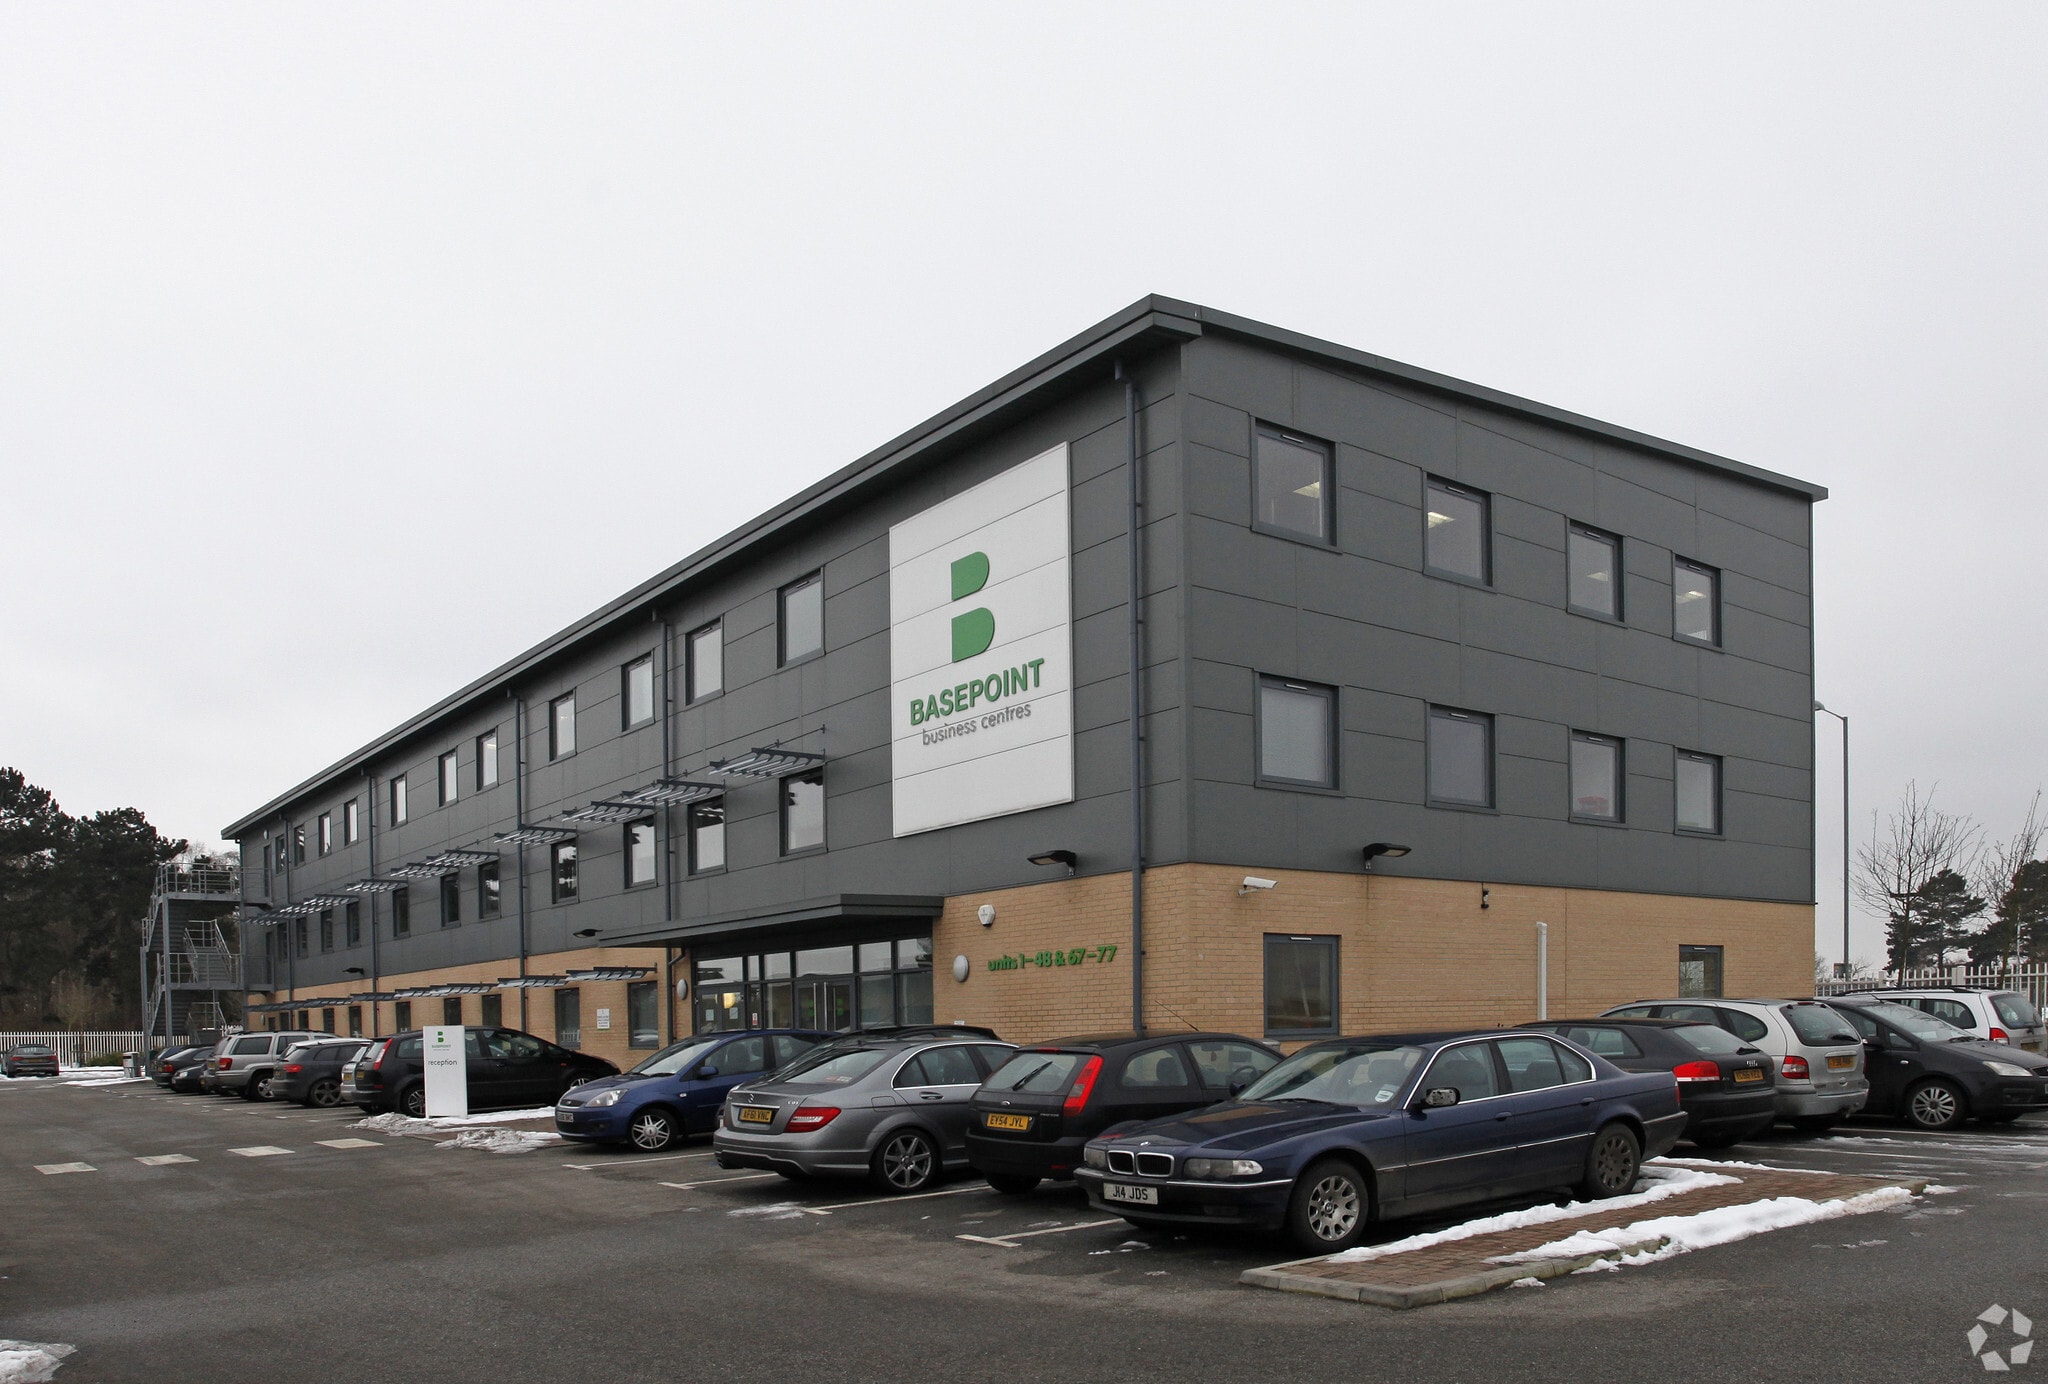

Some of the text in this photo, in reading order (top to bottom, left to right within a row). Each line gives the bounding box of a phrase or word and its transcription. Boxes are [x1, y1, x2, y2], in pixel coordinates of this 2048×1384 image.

[909, 657, 1045, 726] BASEPOINT
[922, 704, 1032, 745] business centres
[988, 953, 1017, 971] units
[1054, 950, 1066, 966] &
[1067, 945, 1118, 965] 67-77
[427, 1058, 458, 1067] reception
[989, 1114, 1024, 1128] EY54 JYL
[1129, 1186, 1148, 1201] JDS
